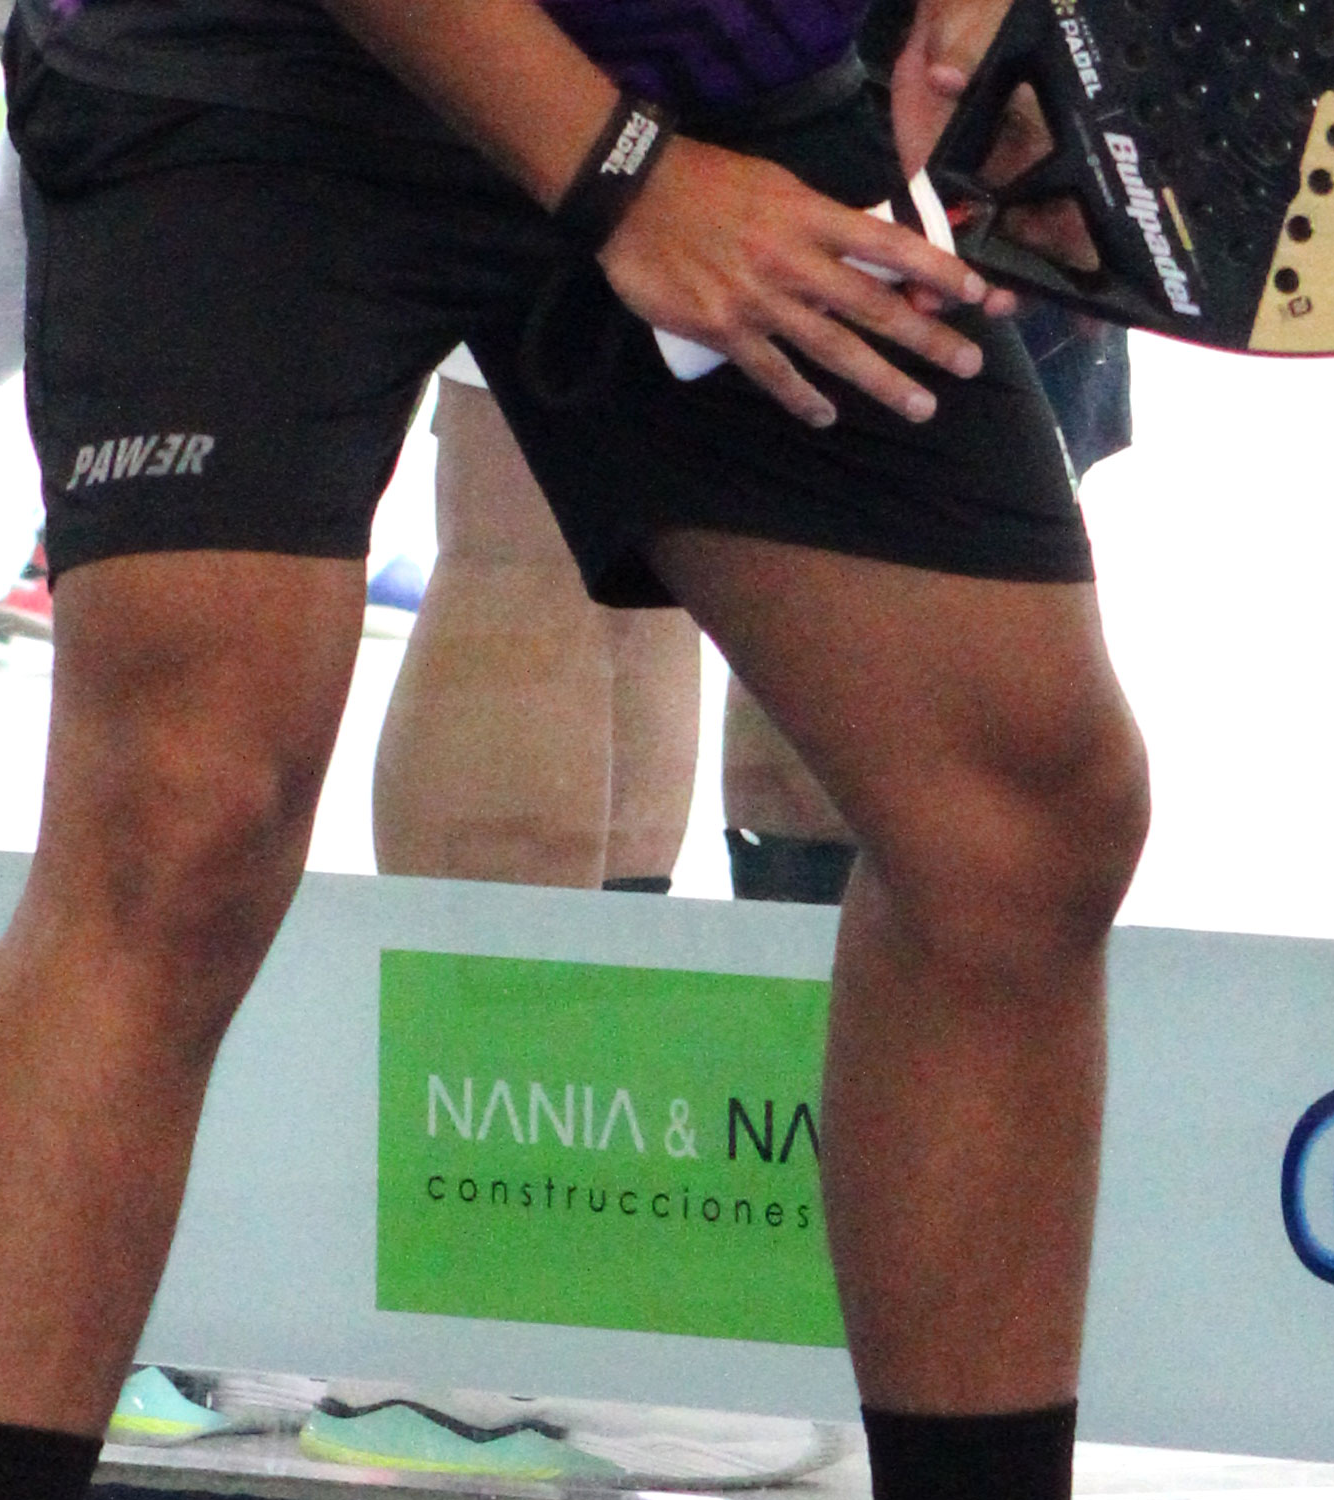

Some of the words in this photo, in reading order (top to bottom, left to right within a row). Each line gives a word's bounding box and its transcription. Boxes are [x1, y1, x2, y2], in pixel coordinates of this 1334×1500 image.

[1060, 18, 1103, 100] PADEL
[1103, 131, 1203, 317] Bullpadel
[426, 1073, 646, 1154] NANIA
[663, 1098, 699, 1160] &
[426, 1174, 811, 1230] construcciones
